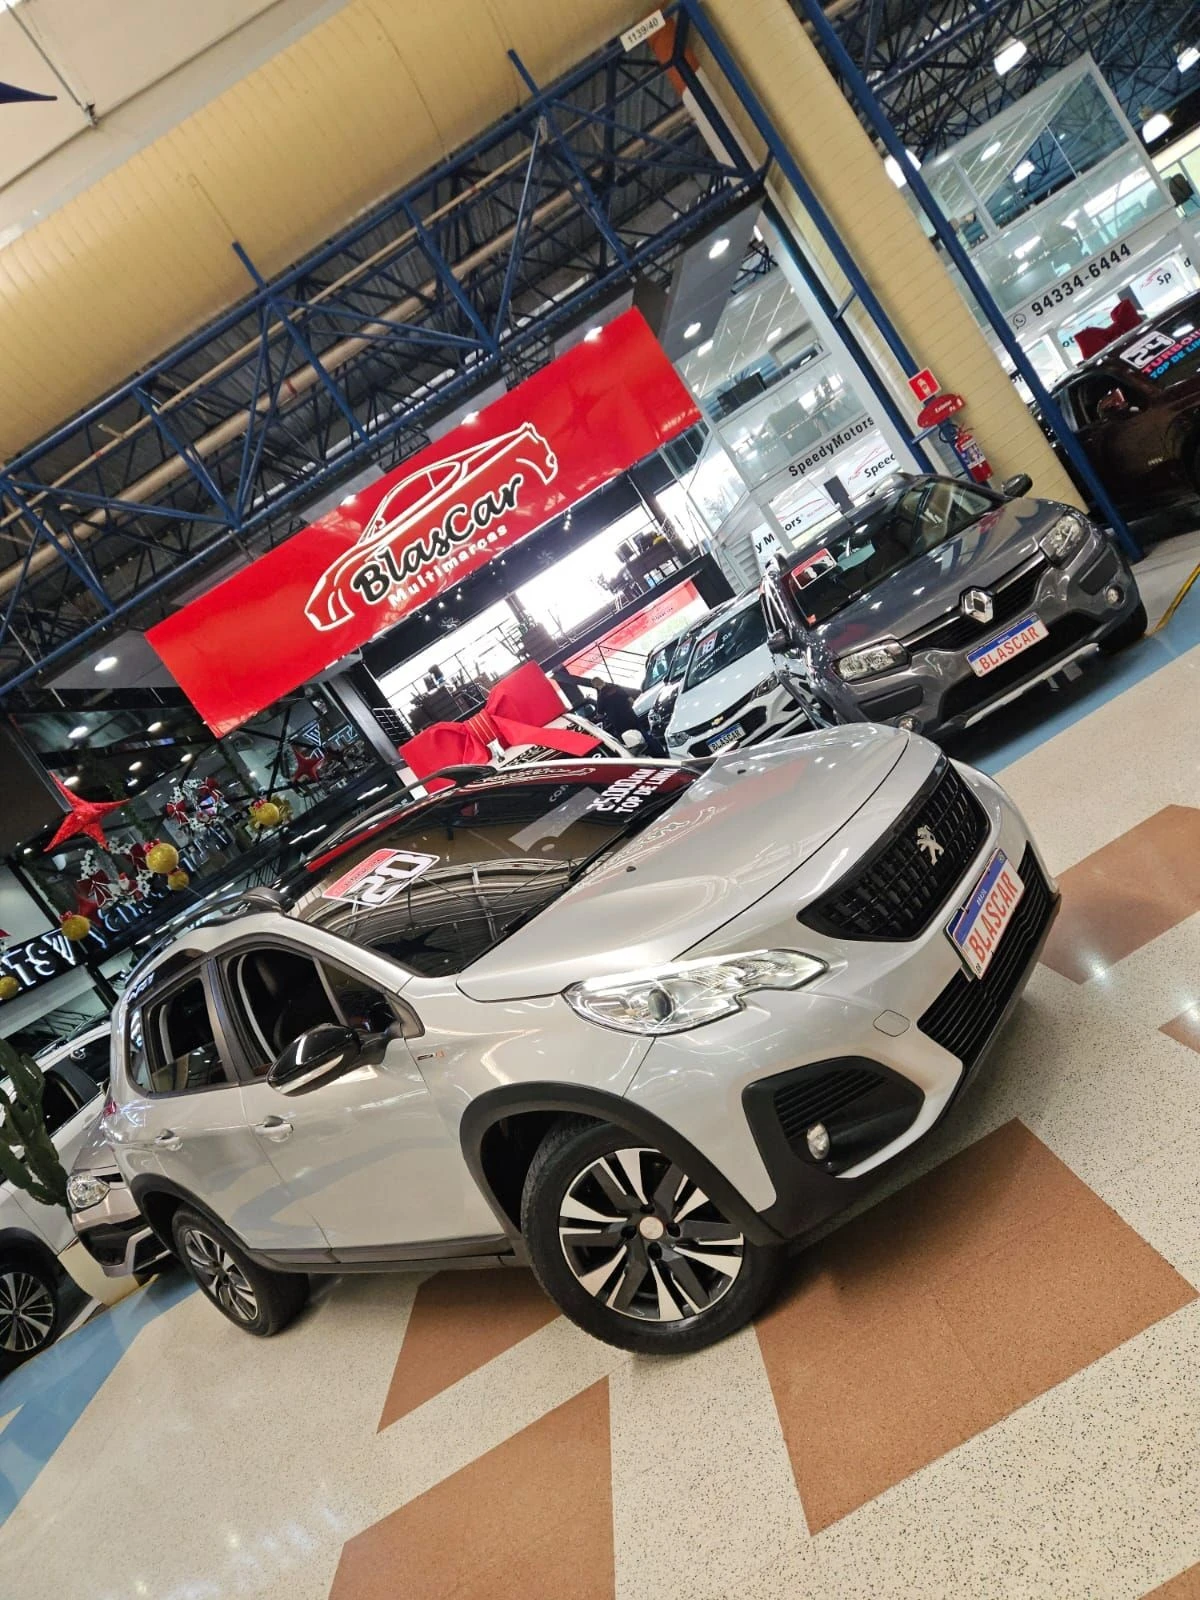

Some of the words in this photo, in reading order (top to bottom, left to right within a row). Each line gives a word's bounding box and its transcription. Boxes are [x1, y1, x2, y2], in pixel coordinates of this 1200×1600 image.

[1031, 243, 1131, 316] 94334-6444
[1129, 336, 1172, 367] 24
[788, 416, 875, 477] SpeedyMotors
[351, 474, 524, 603] BlasCar
[387, 525, 508, 607] Multimarcas
[979, 626, 1040, 670] BLASCAR
[711, 729, 741, 751] BLASCAR
[613, 796, 644, 814] TOP
[633, 784, 658, 796] DE
[344, 853, 433, 903] 20
[968, 871, 1019, 964] BLASCAR
